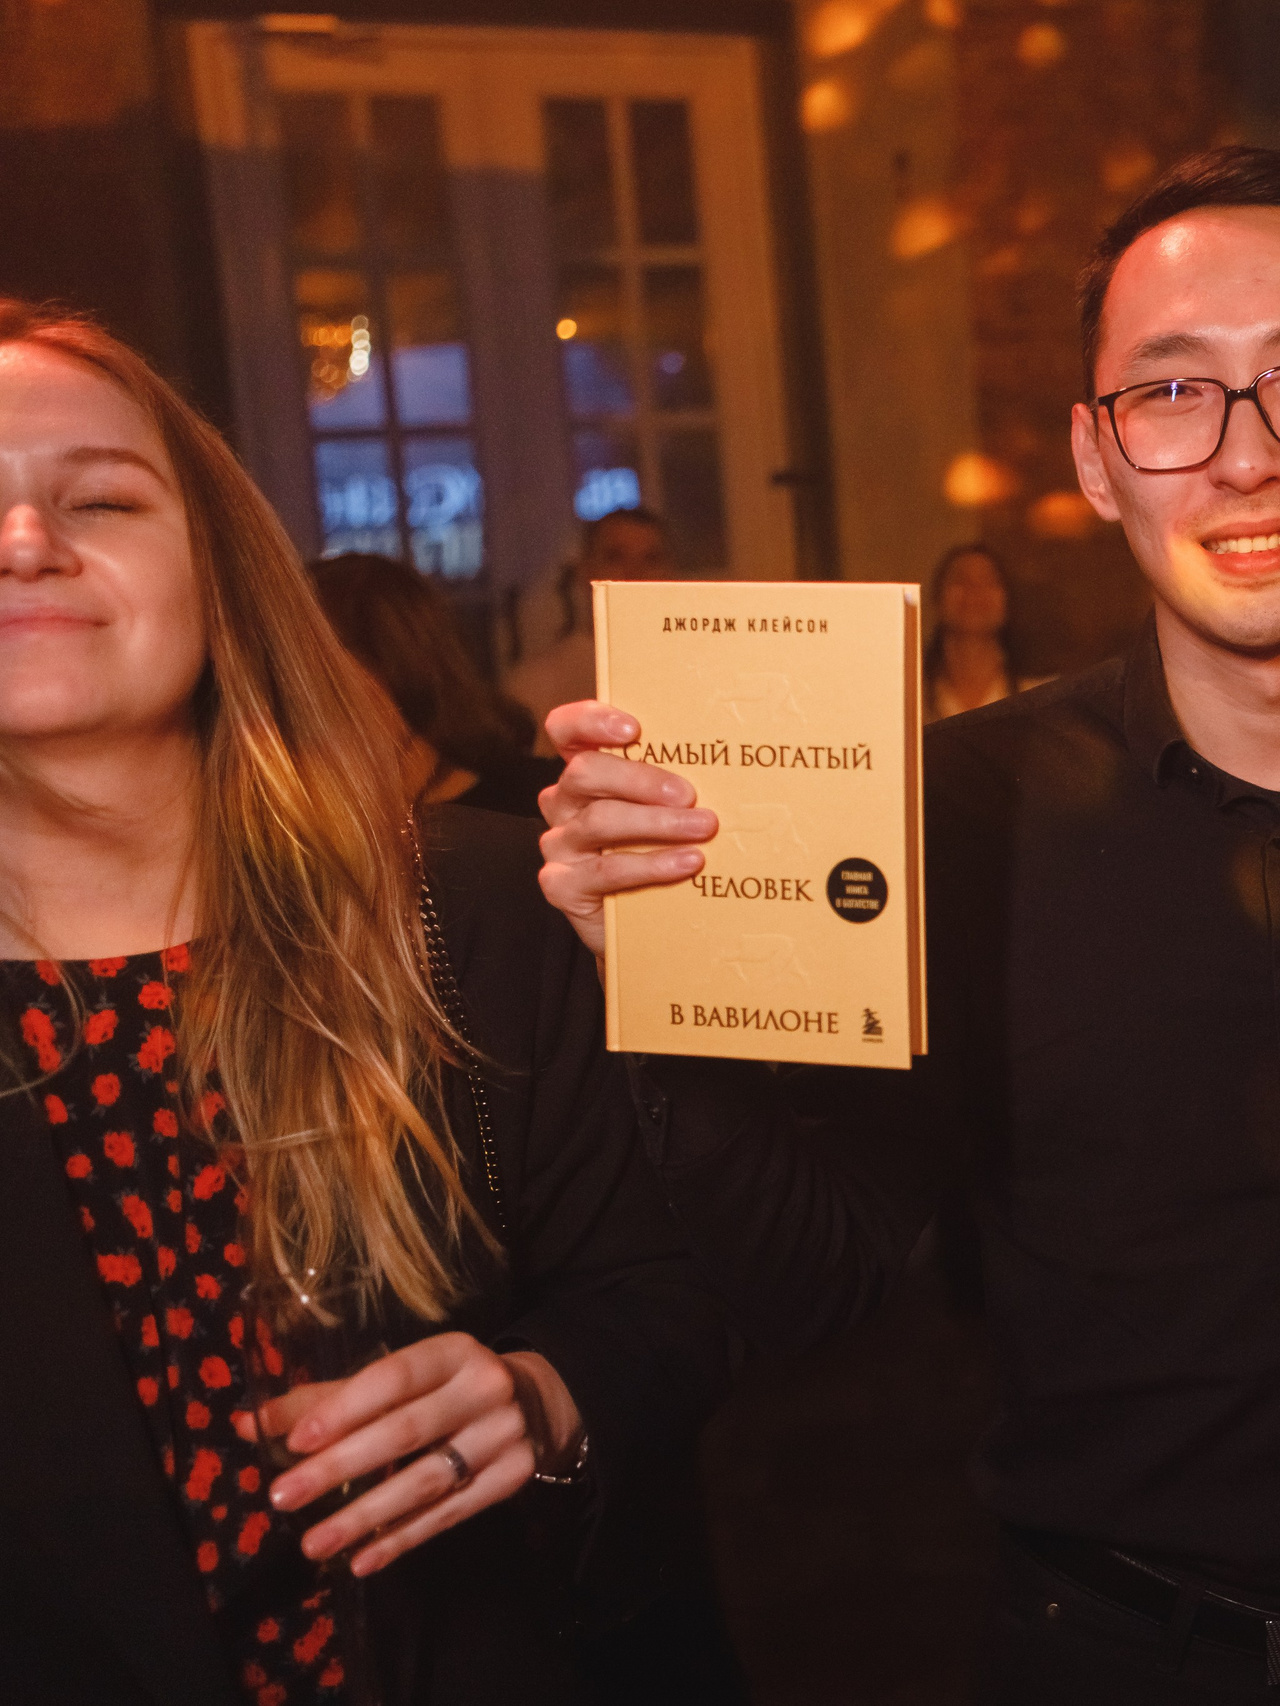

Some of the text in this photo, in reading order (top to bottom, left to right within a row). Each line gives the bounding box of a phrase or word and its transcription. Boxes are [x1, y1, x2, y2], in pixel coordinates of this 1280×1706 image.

[662, 616, 829, 633] ДЖОРДЖ КЛЕЙСОН
[623, 739, 872, 770] САМЫЙ БОГАТЫЙ
[691, 875, 814, 902] ЧЕЛОВЕК
[670, 1003, 839, 1034] В ВАВИЛОНЕ
